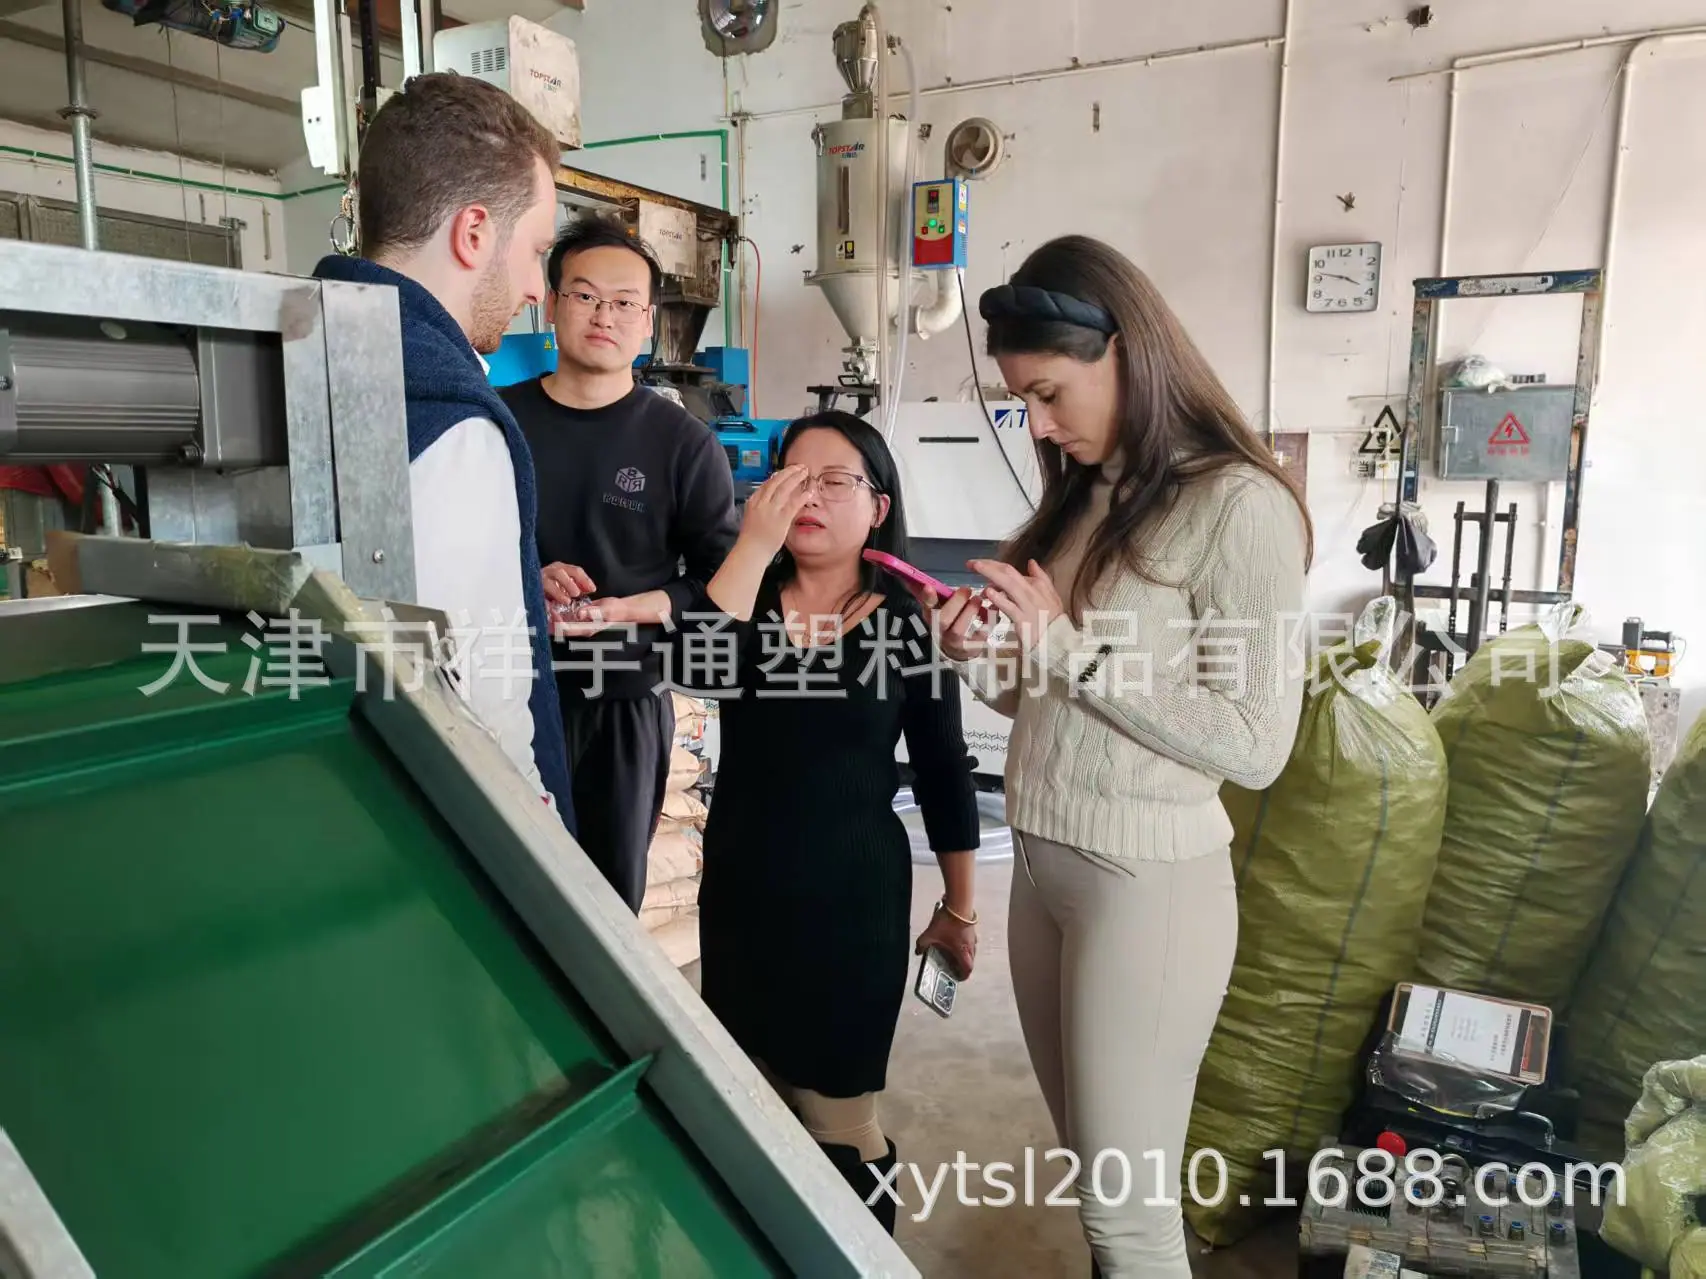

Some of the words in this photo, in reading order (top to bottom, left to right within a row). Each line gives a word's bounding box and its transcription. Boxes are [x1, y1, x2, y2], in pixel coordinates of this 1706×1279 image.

[1339, 247, 1352, 258] 12
[1314, 259, 1325, 269] 10
[1367, 256, 1376, 266] 2
[1364, 287, 1374, 296] 4
[1324, 298, 1333, 307] 7
